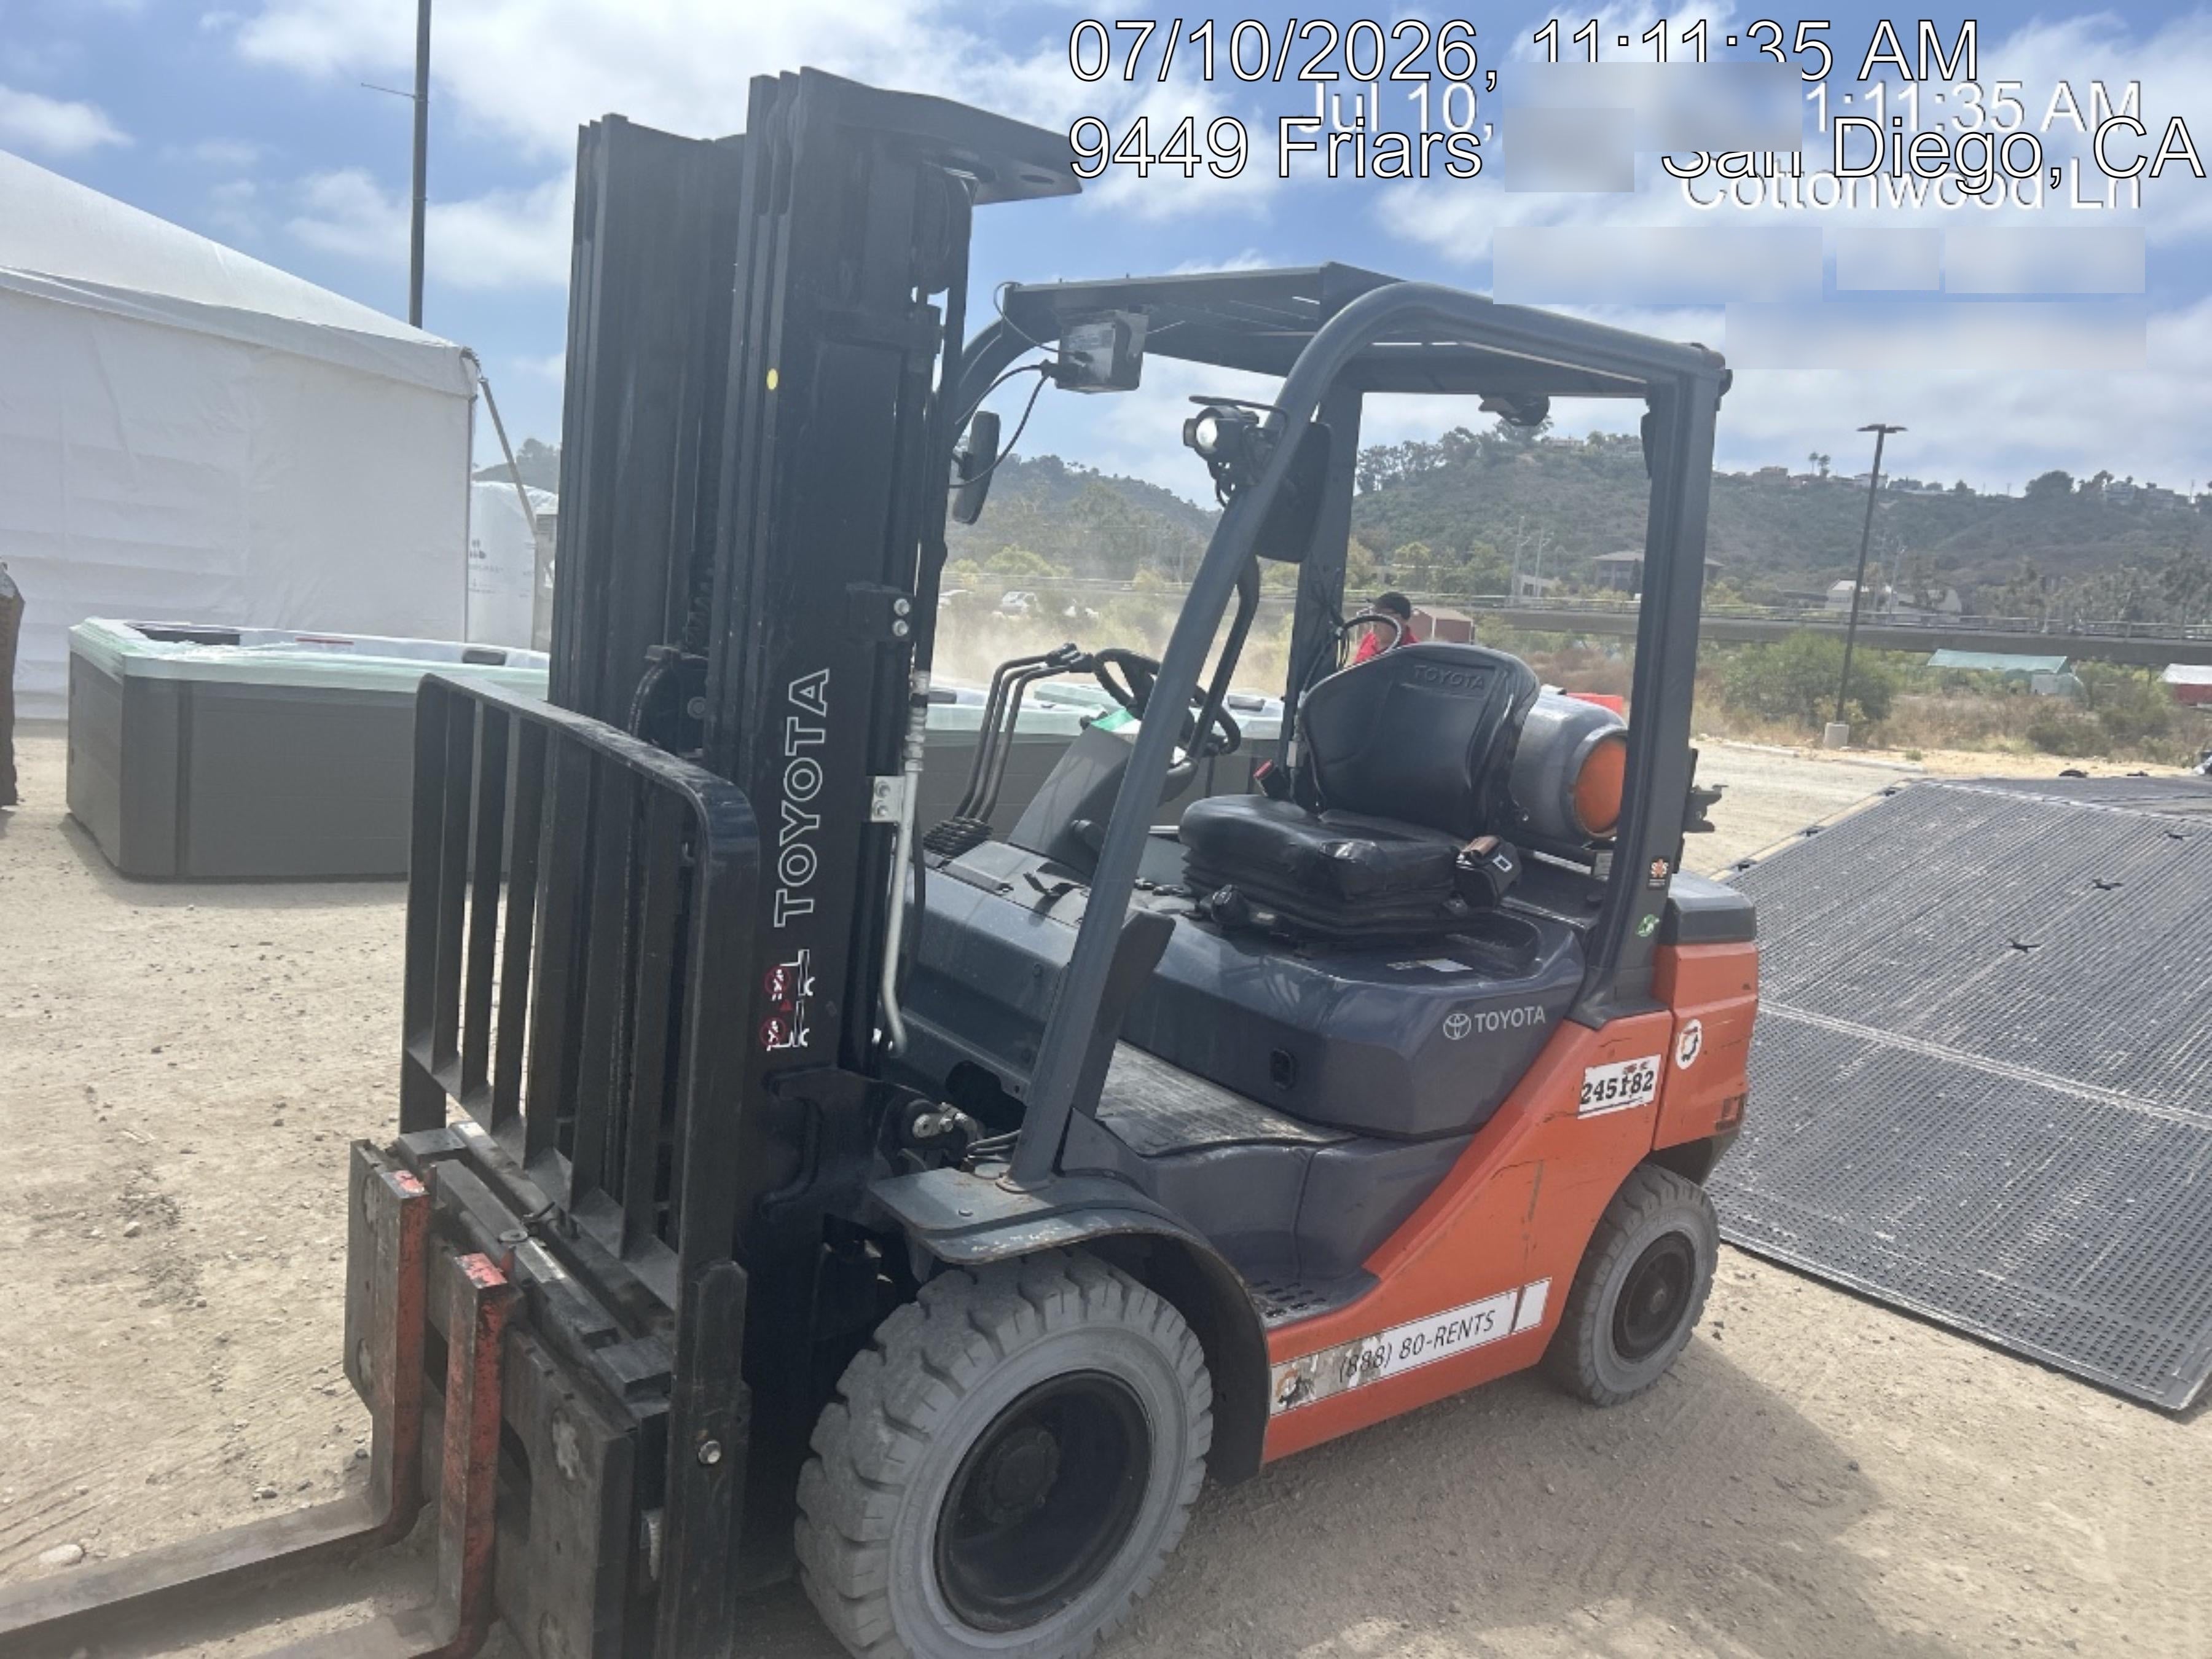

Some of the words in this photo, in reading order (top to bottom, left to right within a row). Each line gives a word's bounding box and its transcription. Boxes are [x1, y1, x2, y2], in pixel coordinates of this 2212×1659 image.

[1415, 665, 1484, 689] TOYOTA
[774, 668, 830, 927] TOYOTA
[1475, 1005, 1546, 1033] TOYOTA
[1399, 1310, 1495, 1359] 80-RENTS
